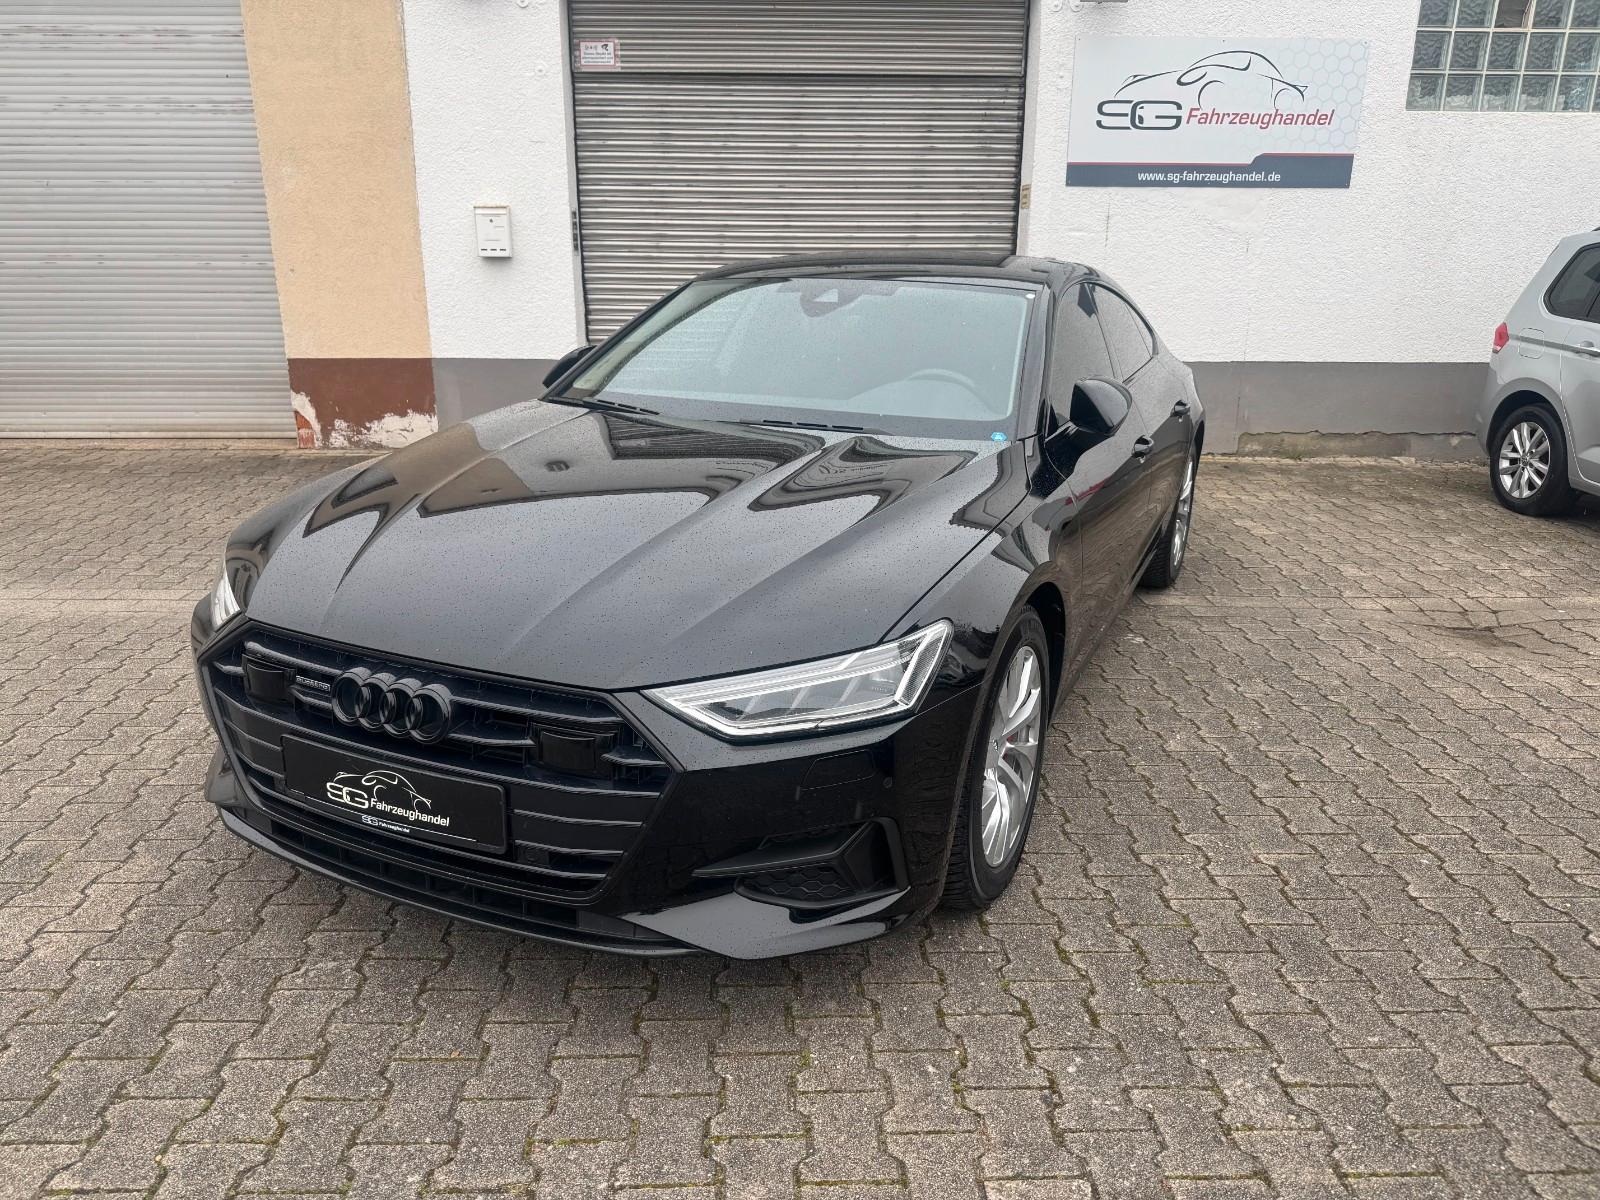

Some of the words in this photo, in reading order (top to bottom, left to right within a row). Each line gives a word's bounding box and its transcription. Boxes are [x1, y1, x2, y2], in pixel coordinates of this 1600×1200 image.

[1095, 99, 1183, 130] SG
[1186, 107, 1336, 130] Fahrzeughandel
[1137, 170, 1281, 184] www.sg-fahrzeughandel.de
[326, 782, 369, 809] SG
[370, 798, 450, 827] Fahrzeughandel
[361, 814, 379, 826] SG
